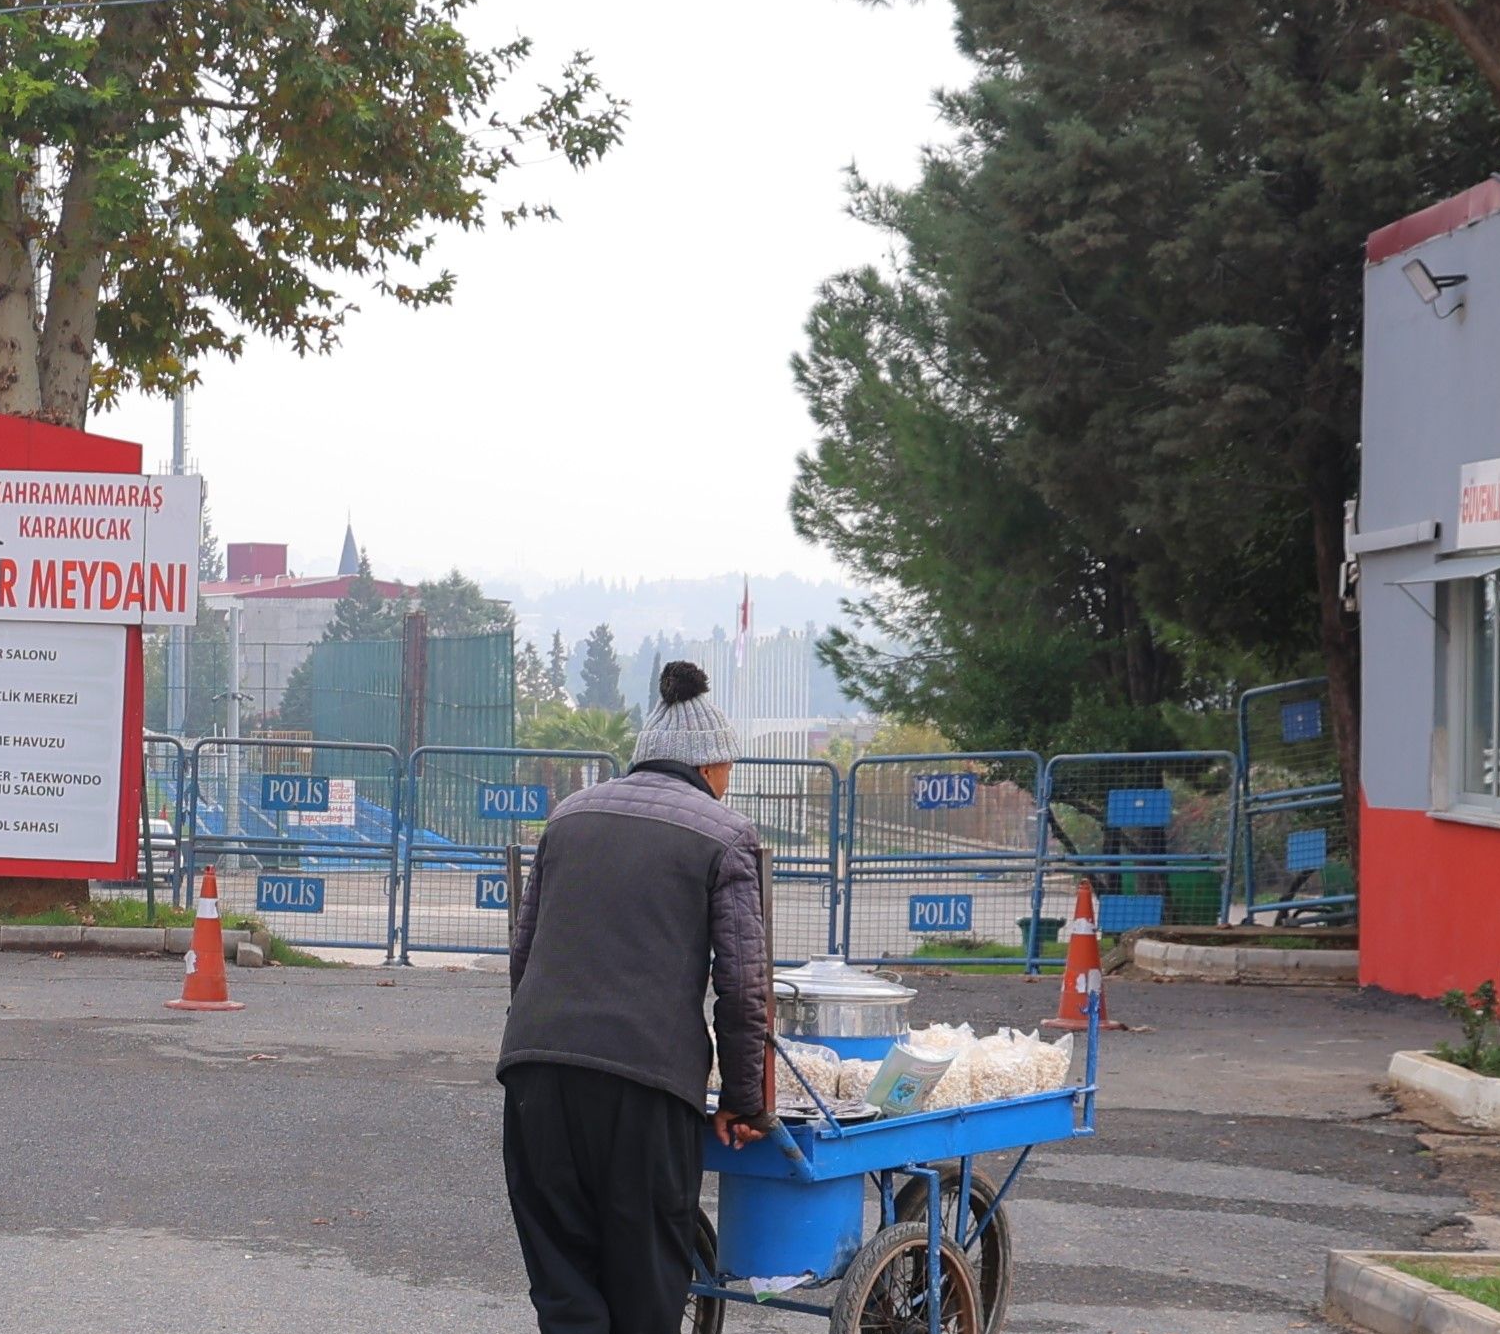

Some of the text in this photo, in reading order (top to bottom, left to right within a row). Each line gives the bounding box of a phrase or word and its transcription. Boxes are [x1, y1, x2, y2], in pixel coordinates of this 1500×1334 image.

[19, 516, 132, 540] KARAKUCAK
[28, 559, 188, 613] MEYDANI
[6, 649, 57, 661] SALONU
[24, 692, 78, 705] MERKEZİ
[13, 736, 65, 748] HAVUZU
[14, 784, 64, 797] SALONU
[21, 772, 101, 785] TAEKWONDO
[917, 775, 971, 802] POLİS
[269, 778, 323, 804] POLİS
[484, 786, 538, 812] POLİS
[13, 822, 59, 833] SAHASI
[262, 879, 316, 906] POLİS
[915, 898, 967, 925] POLİS
